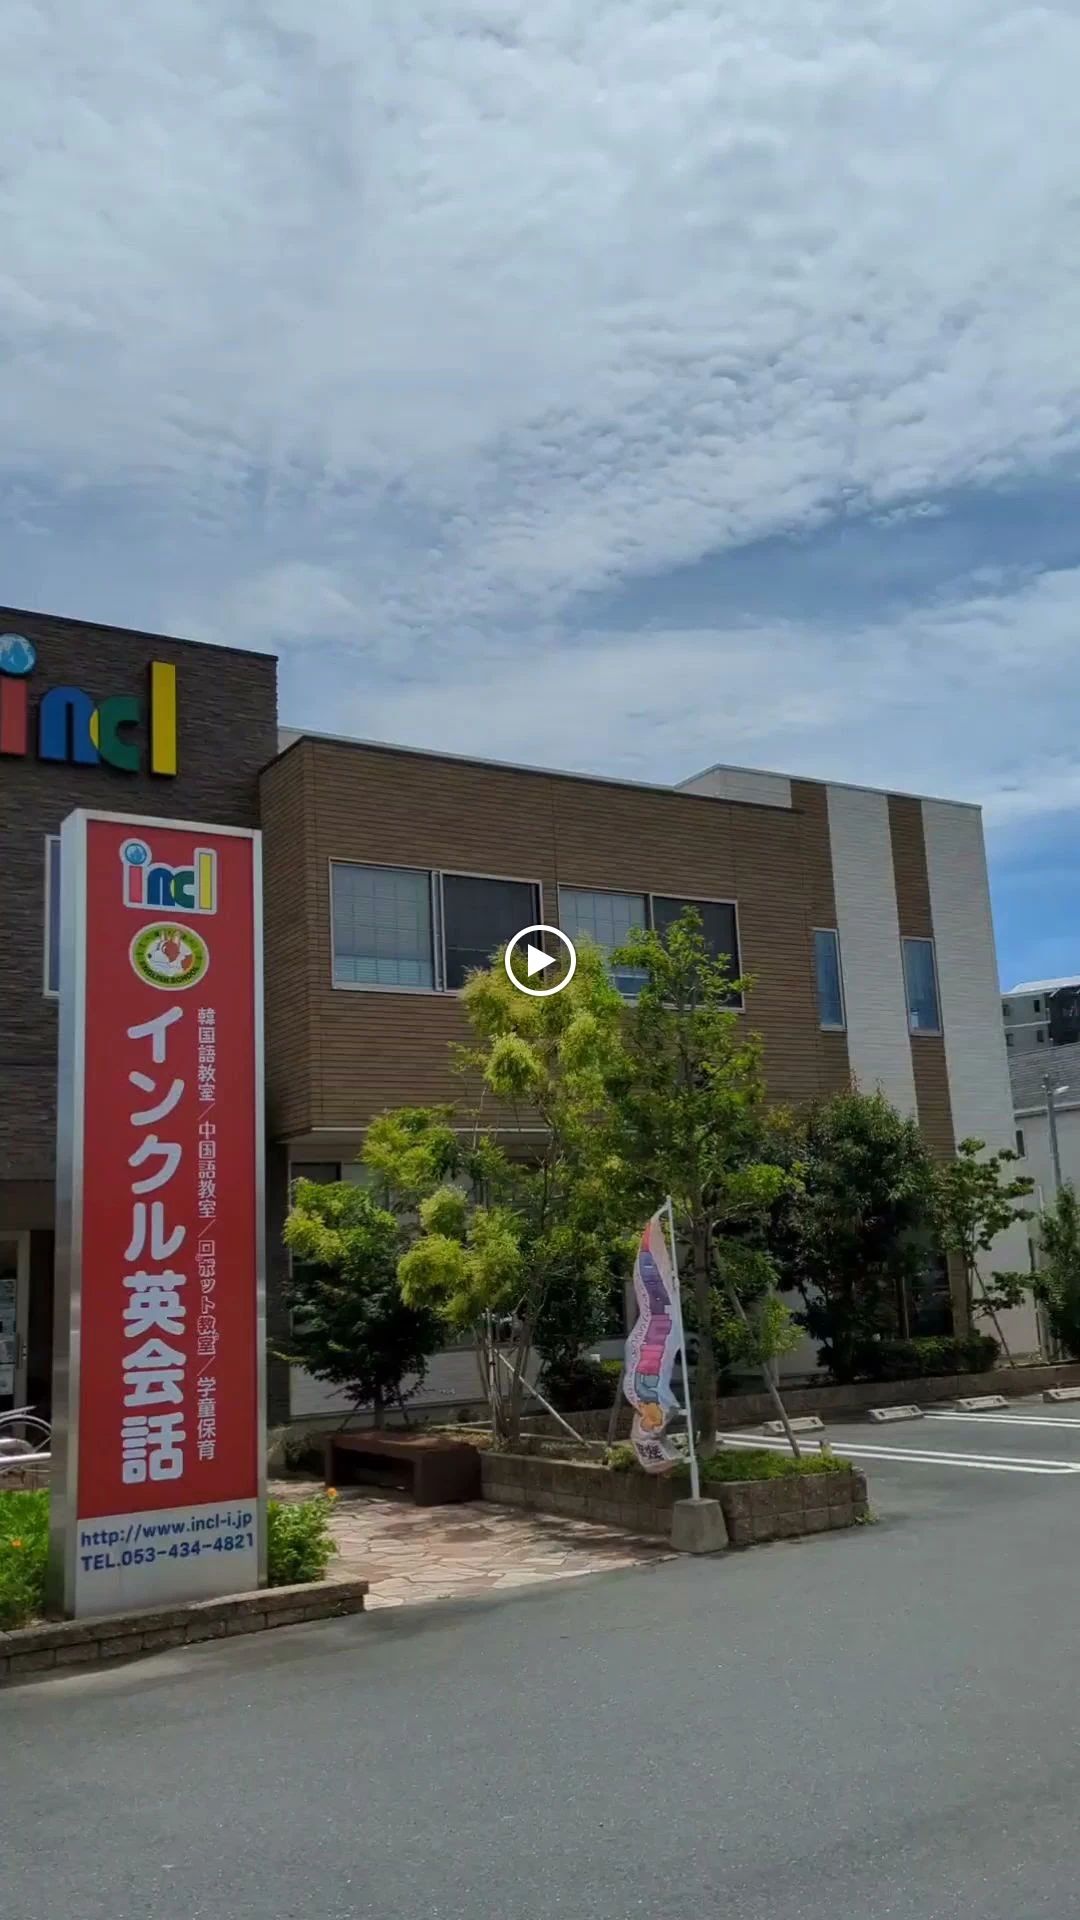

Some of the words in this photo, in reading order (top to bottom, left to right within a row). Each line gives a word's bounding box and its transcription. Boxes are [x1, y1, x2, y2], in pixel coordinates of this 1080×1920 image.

[121, 840, 215, 913] incl
[120, 1005, 187, 1485] インクル英会話
[80, 1510, 252, 1547] http://www.incl-i.jp
[80, 1533, 253, 1571] TEL.053-434-4821
